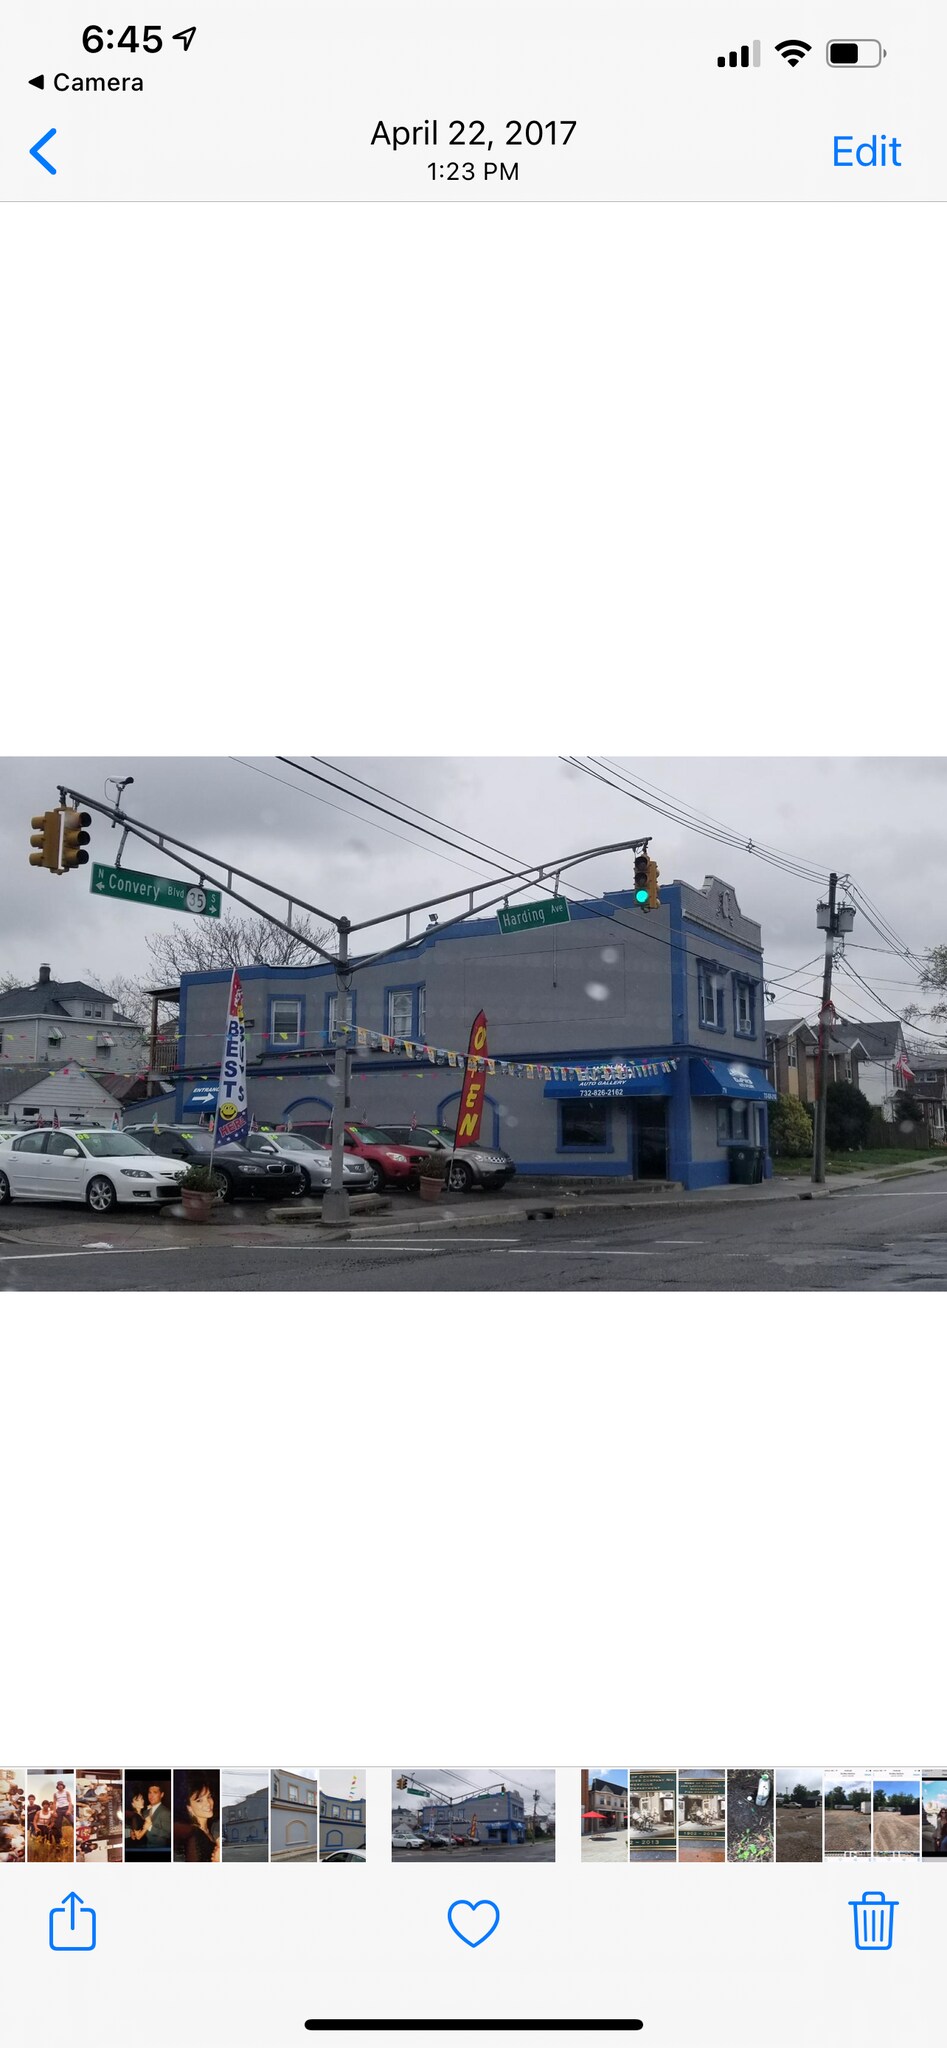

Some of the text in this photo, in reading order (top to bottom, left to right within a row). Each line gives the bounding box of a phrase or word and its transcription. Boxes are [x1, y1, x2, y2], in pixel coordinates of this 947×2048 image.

[82, 25, 163, 53] 6:45
[54, 73, 144, 92] Camera
[371, 120, 577, 151] April 22, 2017
[834, 135, 902, 167] Edit
[428, 162, 519, 181] 1:23 PM
[98, 868, 104, 880] N
[109, 873, 204, 908] Convery Blvd 35
[211, 893, 216, 903] S
[503, 903, 563, 926] Harding Ave
[223, 1021, 239, 1098] BEST
[580, 1089, 624, 1097] 732-826-2162
